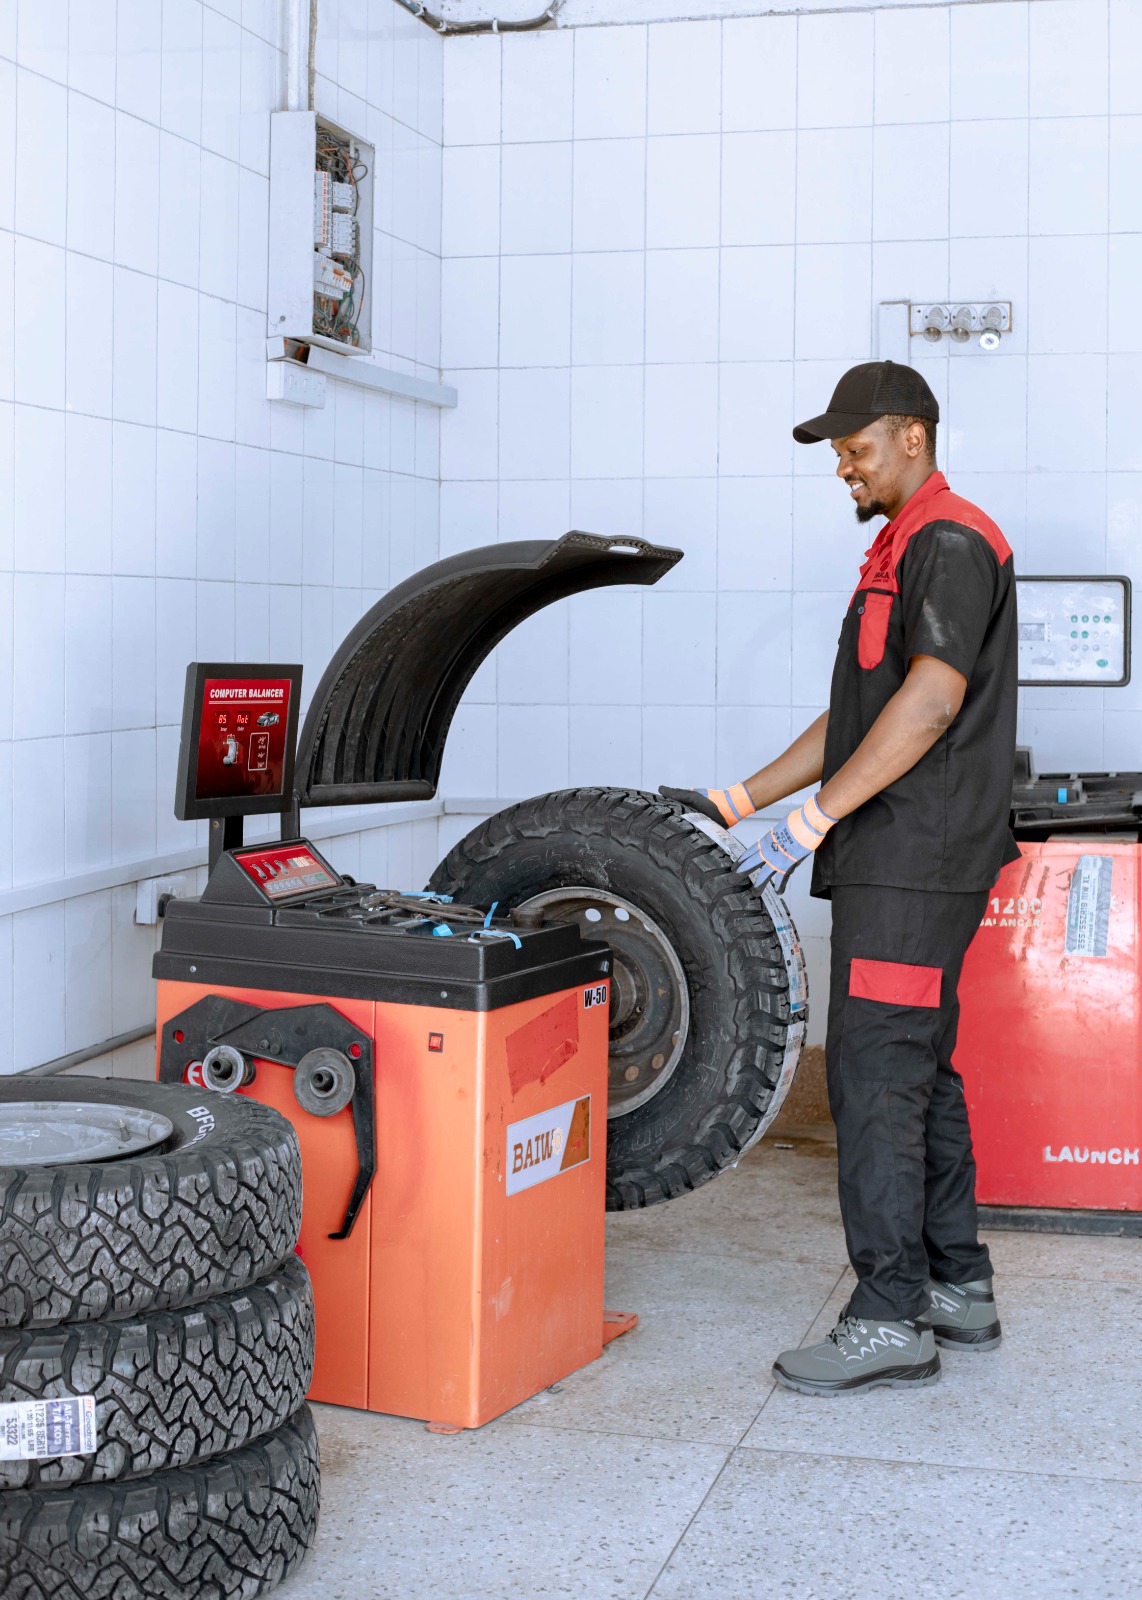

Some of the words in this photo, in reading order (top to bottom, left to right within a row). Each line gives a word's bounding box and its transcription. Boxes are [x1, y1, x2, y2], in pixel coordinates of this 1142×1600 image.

[210, 688, 247, 698] COMPUTER
[249, 688, 284, 698] BALANCER
[990, 897, 1042, 915] 1200
[584, 986, 607, 1008] W-50
[512, 1128, 563, 1174] BAIW
[1045, 1145, 1140, 1165] LAUNCH
[6, 1417, 19, 1446] 53322
[63, 1403, 74, 1452] All-Terrain
